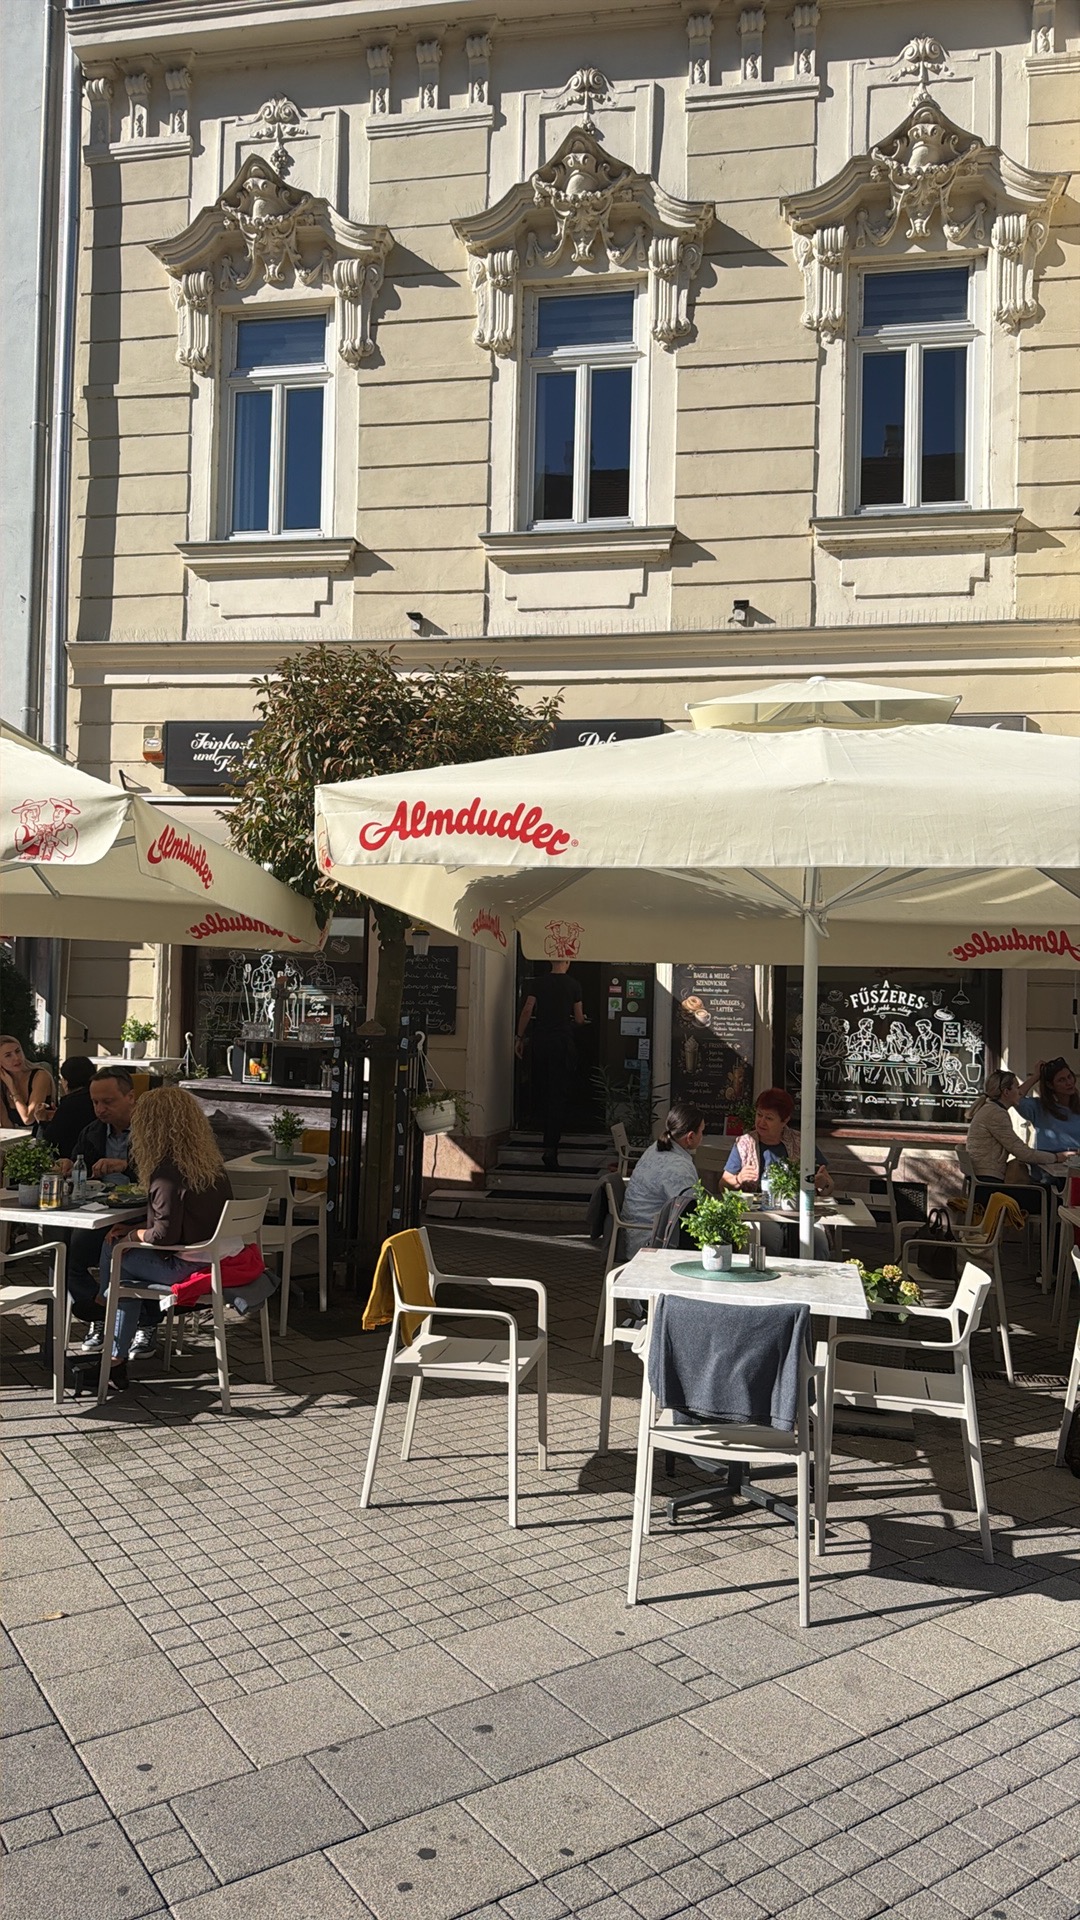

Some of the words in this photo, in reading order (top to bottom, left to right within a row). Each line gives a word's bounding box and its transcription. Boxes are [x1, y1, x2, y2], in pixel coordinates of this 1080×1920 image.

[193, 748, 220, 761] und
[359, 797, 571, 856] Almdudler
[147, 824, 214, 890] Almdudler
[882, 980, 890, 989] A
[850, 987, 926, 1010] FŰSZERES
